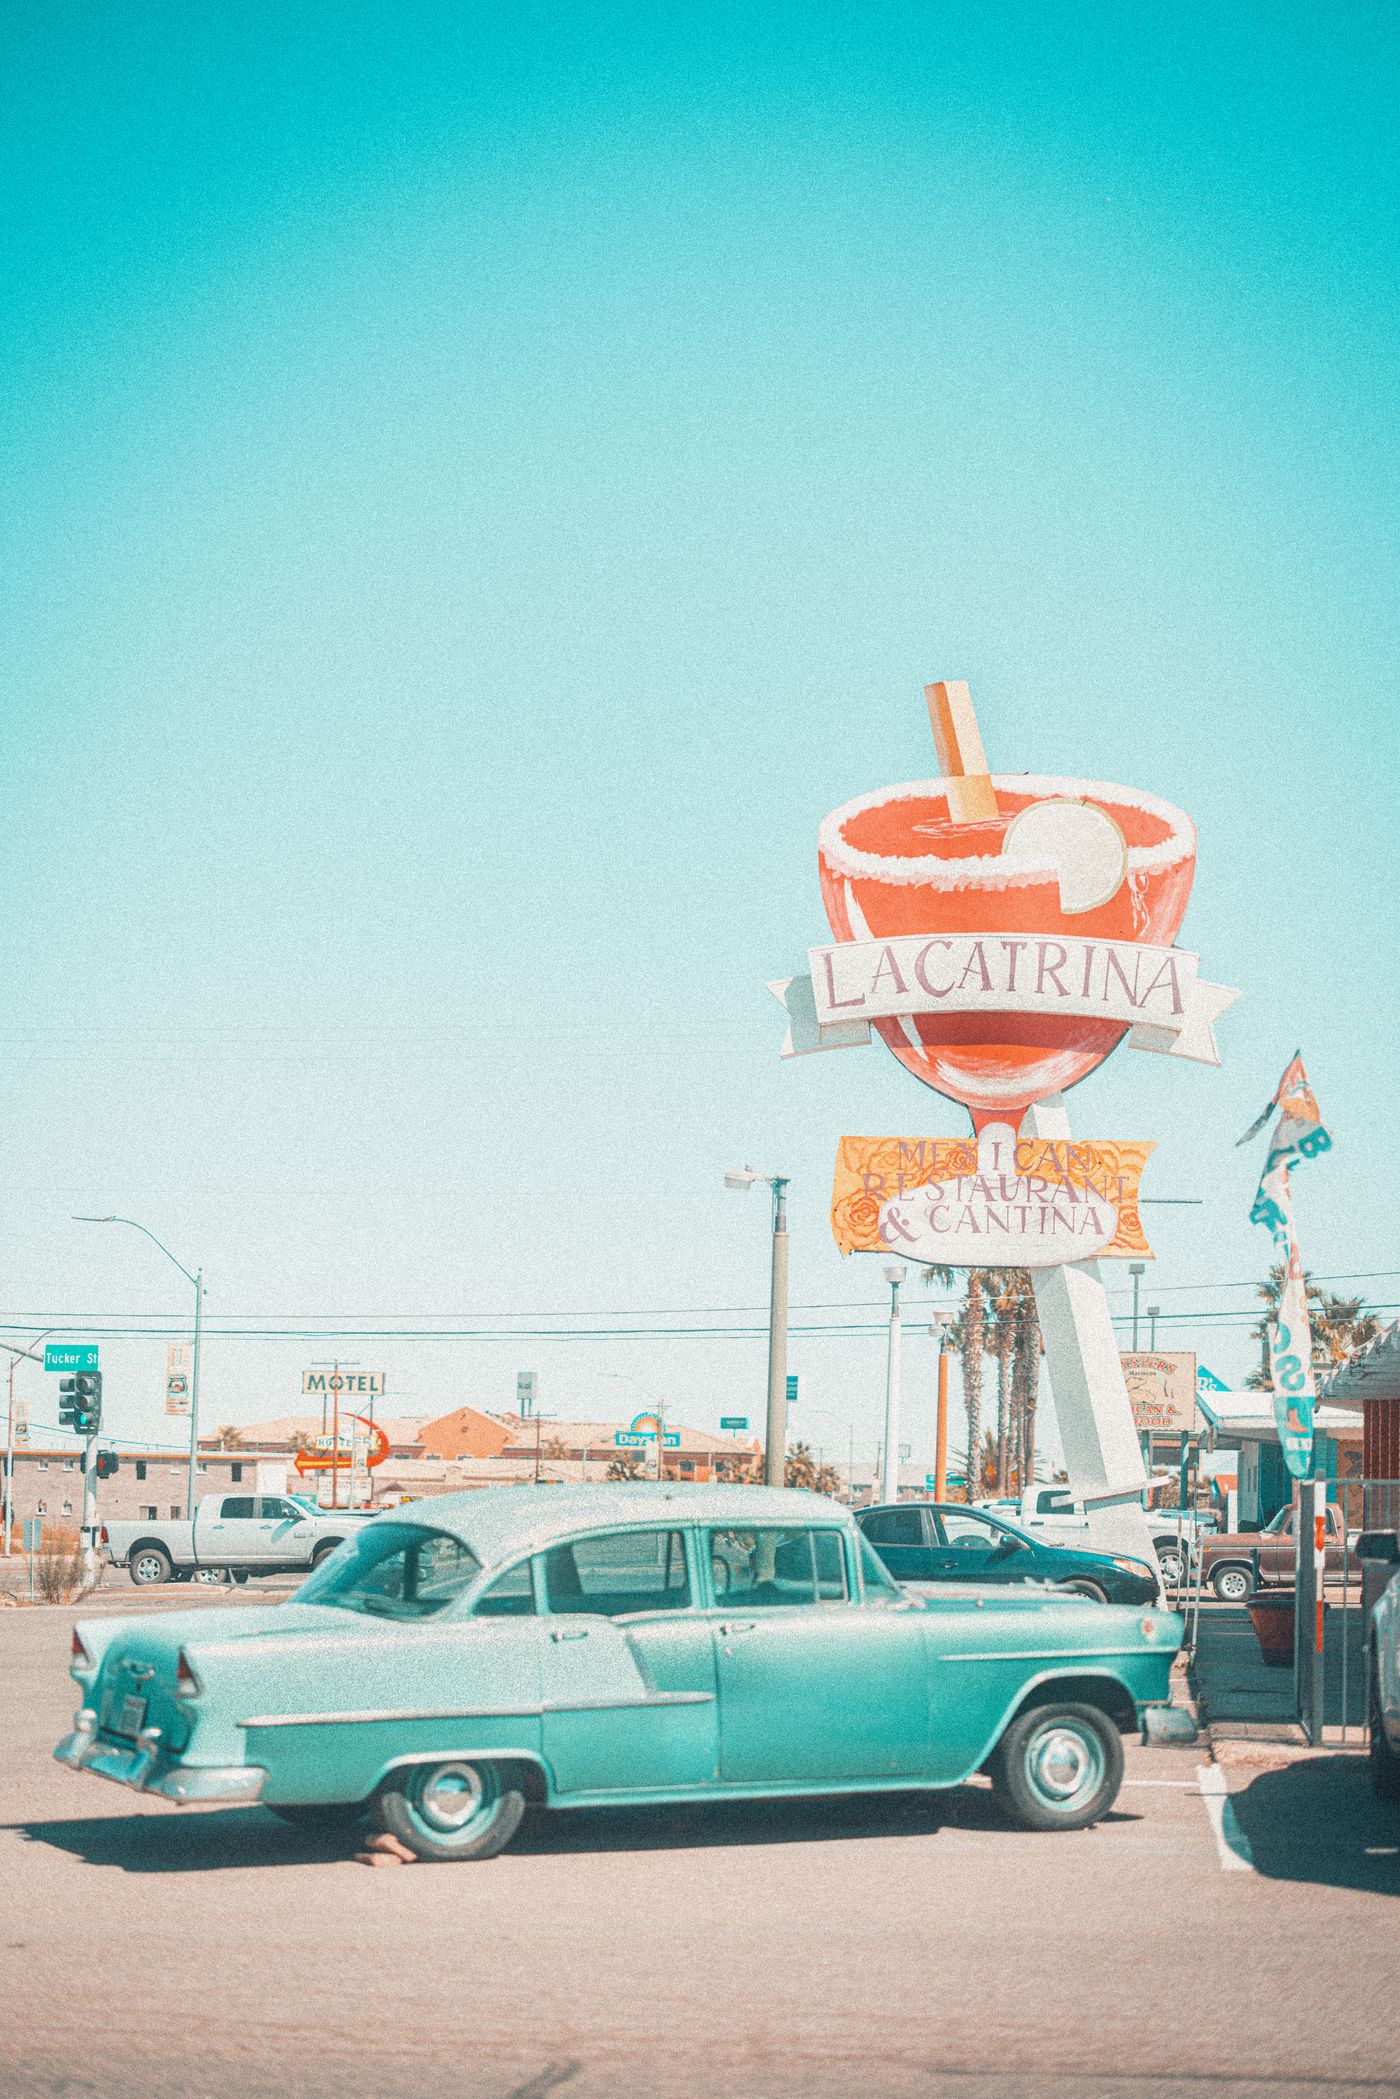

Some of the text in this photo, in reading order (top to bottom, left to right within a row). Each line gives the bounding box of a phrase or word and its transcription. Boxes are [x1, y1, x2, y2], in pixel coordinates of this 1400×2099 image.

[897, 1140, 1092, 1172] MEXICAN
[862, 1172, 1130, 1204] RESTAURANT
[878, 1204, 1106, 1244] & CANTINA
[46, 1352, 98, 1364] Tucker St
[306, 1374, 379, 1392] MOTEL
